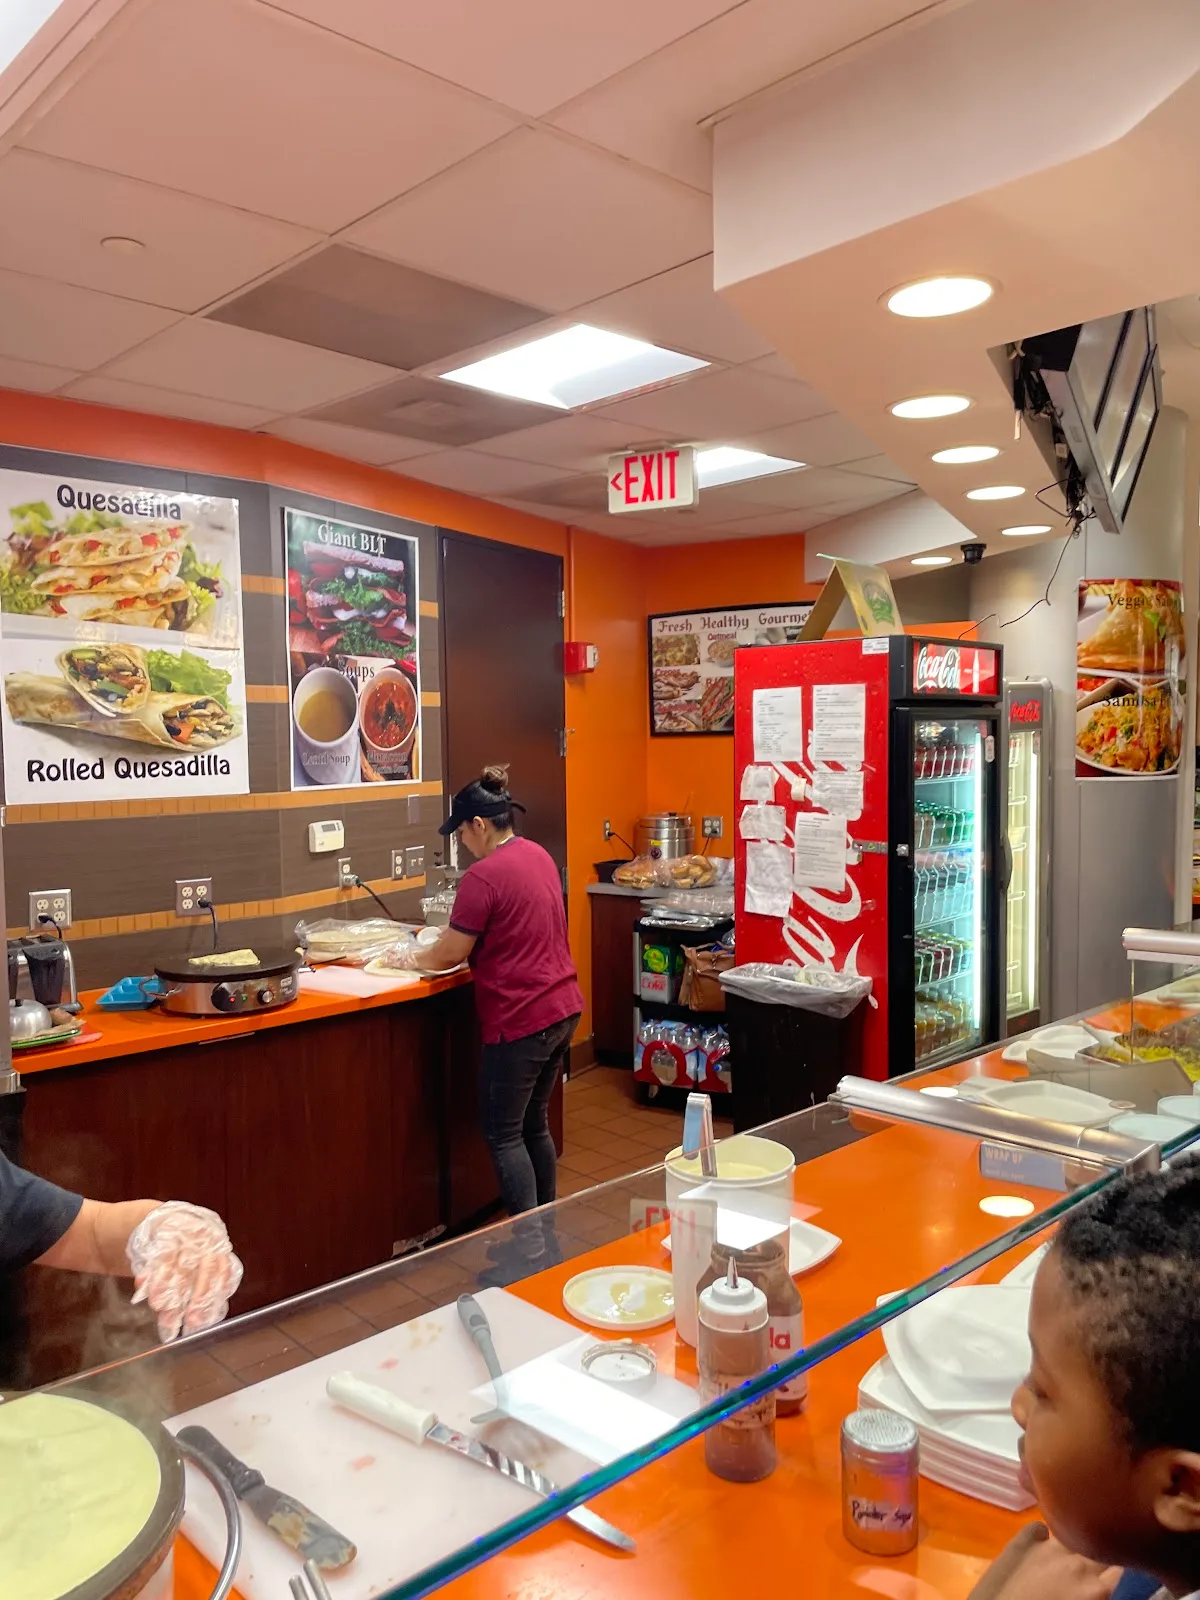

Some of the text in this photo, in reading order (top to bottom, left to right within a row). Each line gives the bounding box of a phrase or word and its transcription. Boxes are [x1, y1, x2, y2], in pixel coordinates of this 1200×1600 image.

[624, 451, 680, 504] EXIT
[57, 484, 182, 520] Quesadilla
[317, 523, 386, 555] Giant BLT
[658, 619, 693, 632] Fresh
[701, 614, 749, 630] Healthy
[707, 631, 737, 641] Oatmeal
[338, 659, 375, 685] Soups
[27, 754, 231, 782] Rolled Quesadilla
[331, 754, 351, 767] Soup
